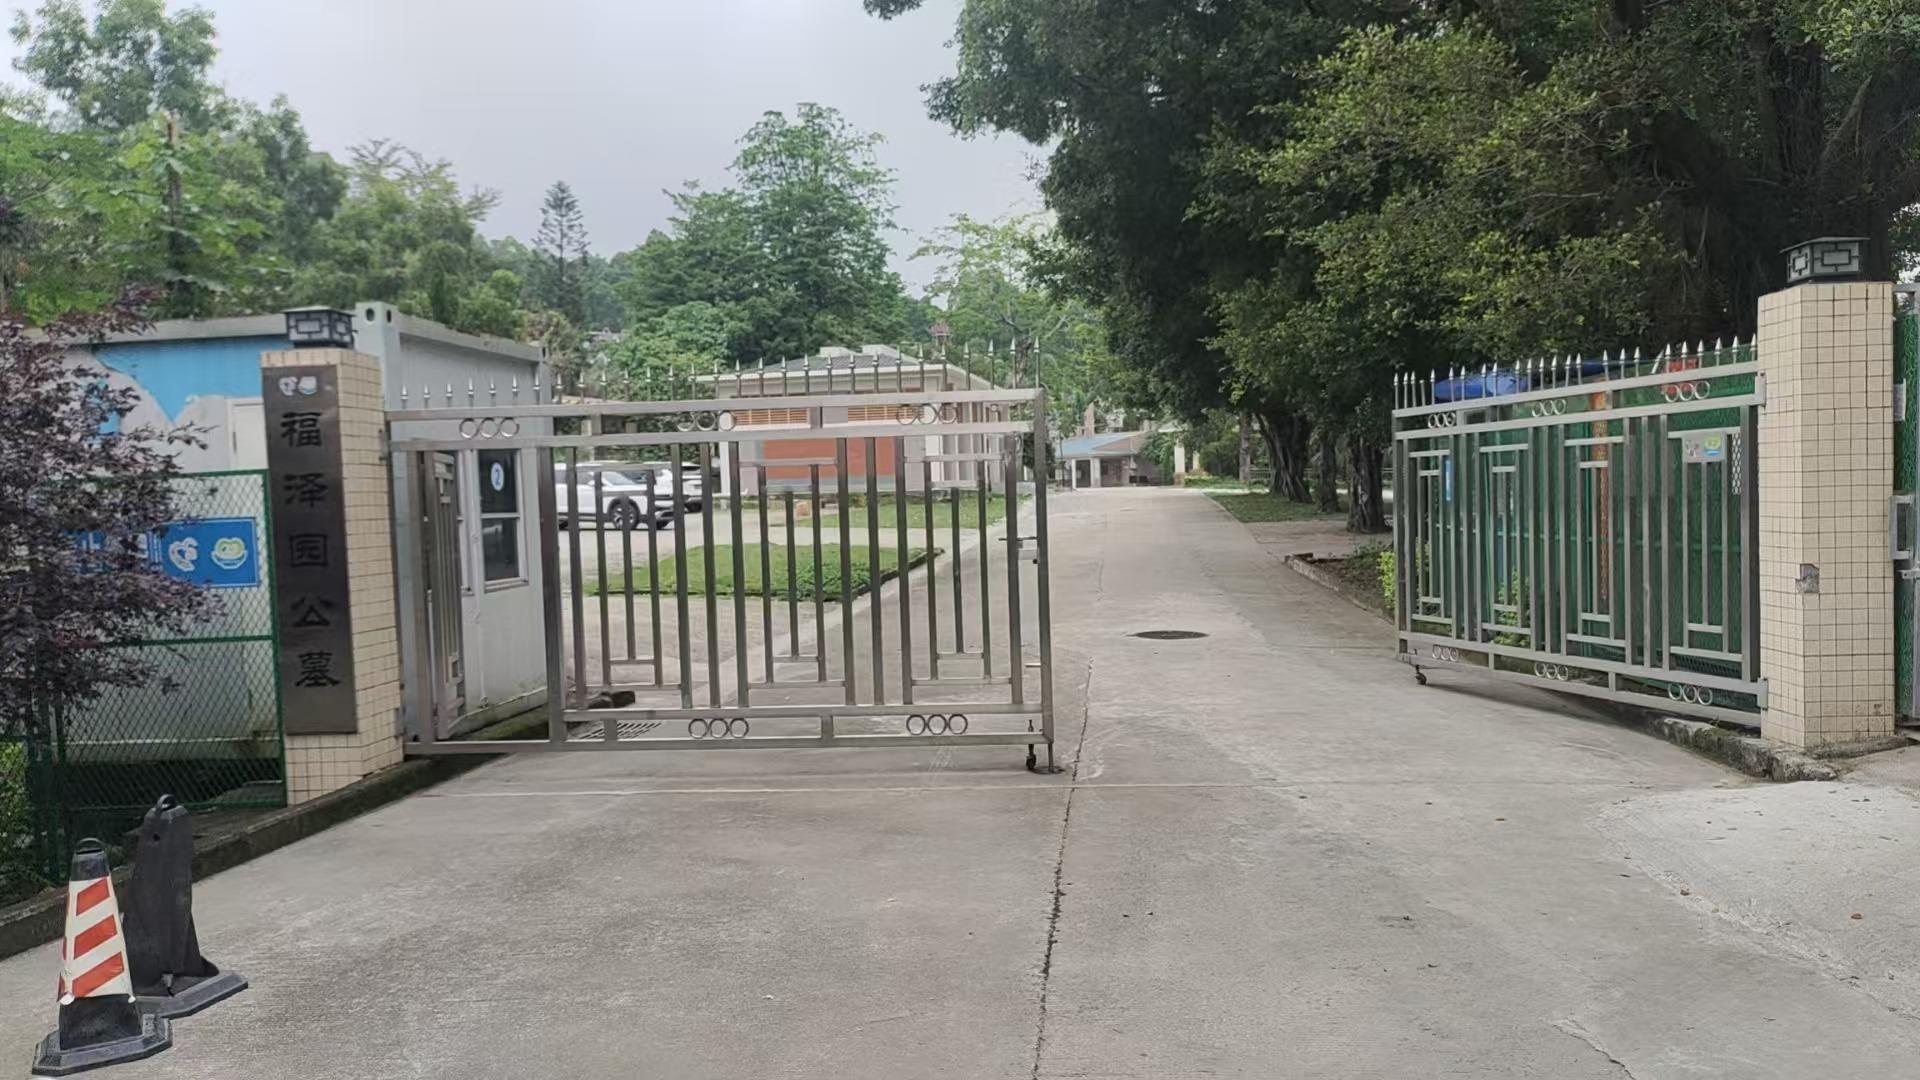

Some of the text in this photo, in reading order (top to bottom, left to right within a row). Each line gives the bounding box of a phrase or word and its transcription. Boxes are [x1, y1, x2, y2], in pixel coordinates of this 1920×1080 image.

[280, 411, 341, 688] 福泽园公墓
